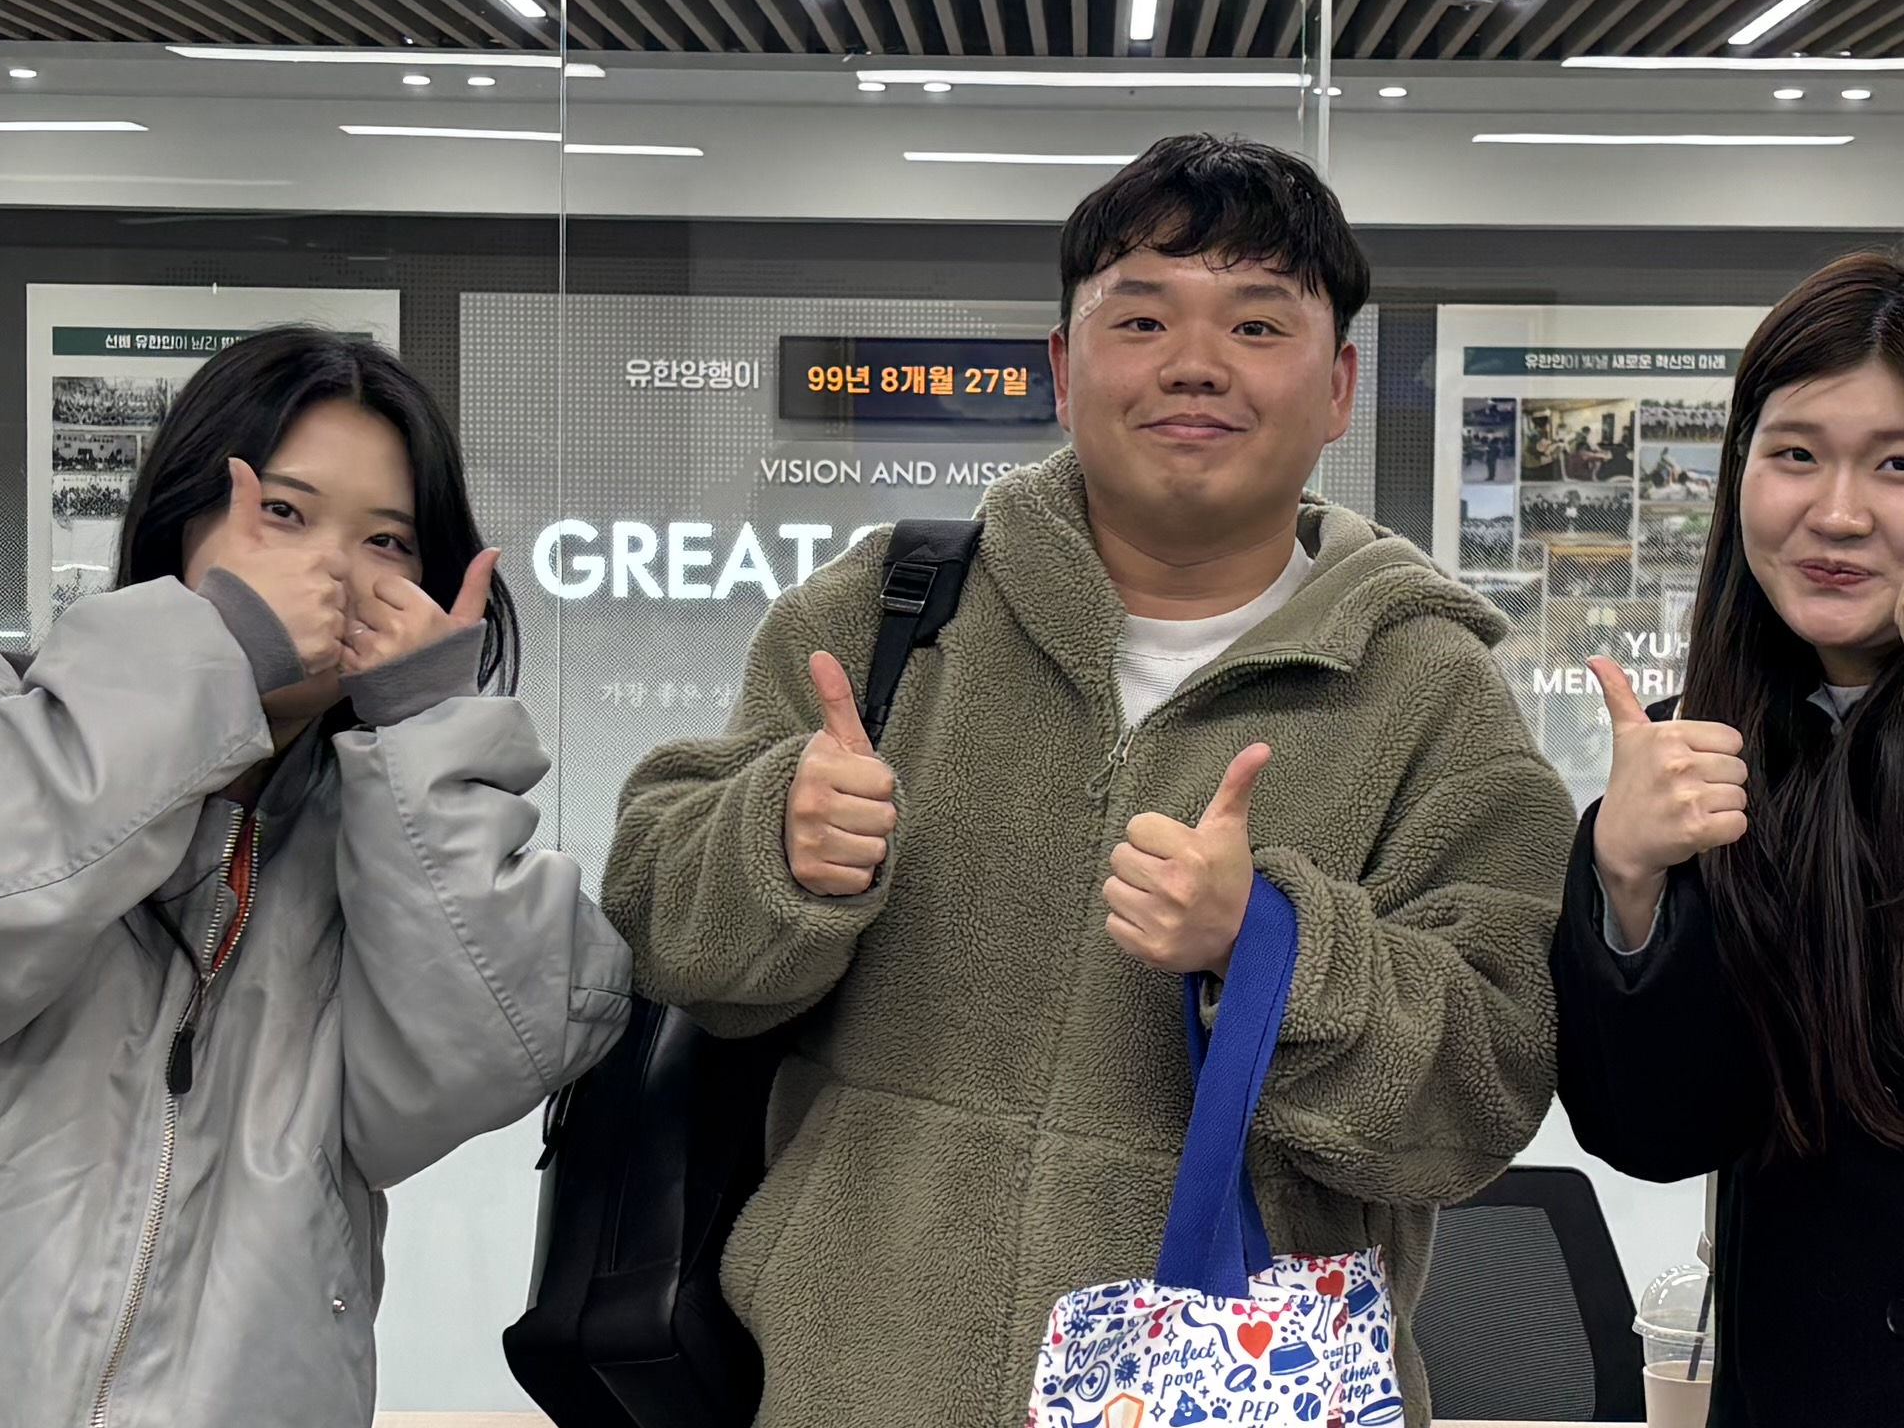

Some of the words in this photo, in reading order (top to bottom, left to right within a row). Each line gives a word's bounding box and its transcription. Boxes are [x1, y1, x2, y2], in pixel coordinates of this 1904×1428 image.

[135, 334, 188, 350] 유한인이
[625, 359, 761, 390] 유한양행이
[1524, 353, 1579, 369] 유한인이
[1612, 353, 1652, 369] 새로운
[1655, 353, 1696, 370] 혁신의
[1698, 354, 1727, 370] 미래
[807, 365, 870, 394] 99년
[881, 365, 954, 395] 8개월
[965, 367, 1027, 396] 27일
[760, 458, 863, 484] VISION
[870, 459, 937, 486] AND
[945, 461, 1043, 486] MISS
[532, 518, 833, 600] GREAT
[1624, 631, 1691, 659] YUH
[1148, 1337, 1218, 1377] perfect
[1160, 1369, 1206, 1400] poop
[1238, 1399, 1280, 1422] PEP
